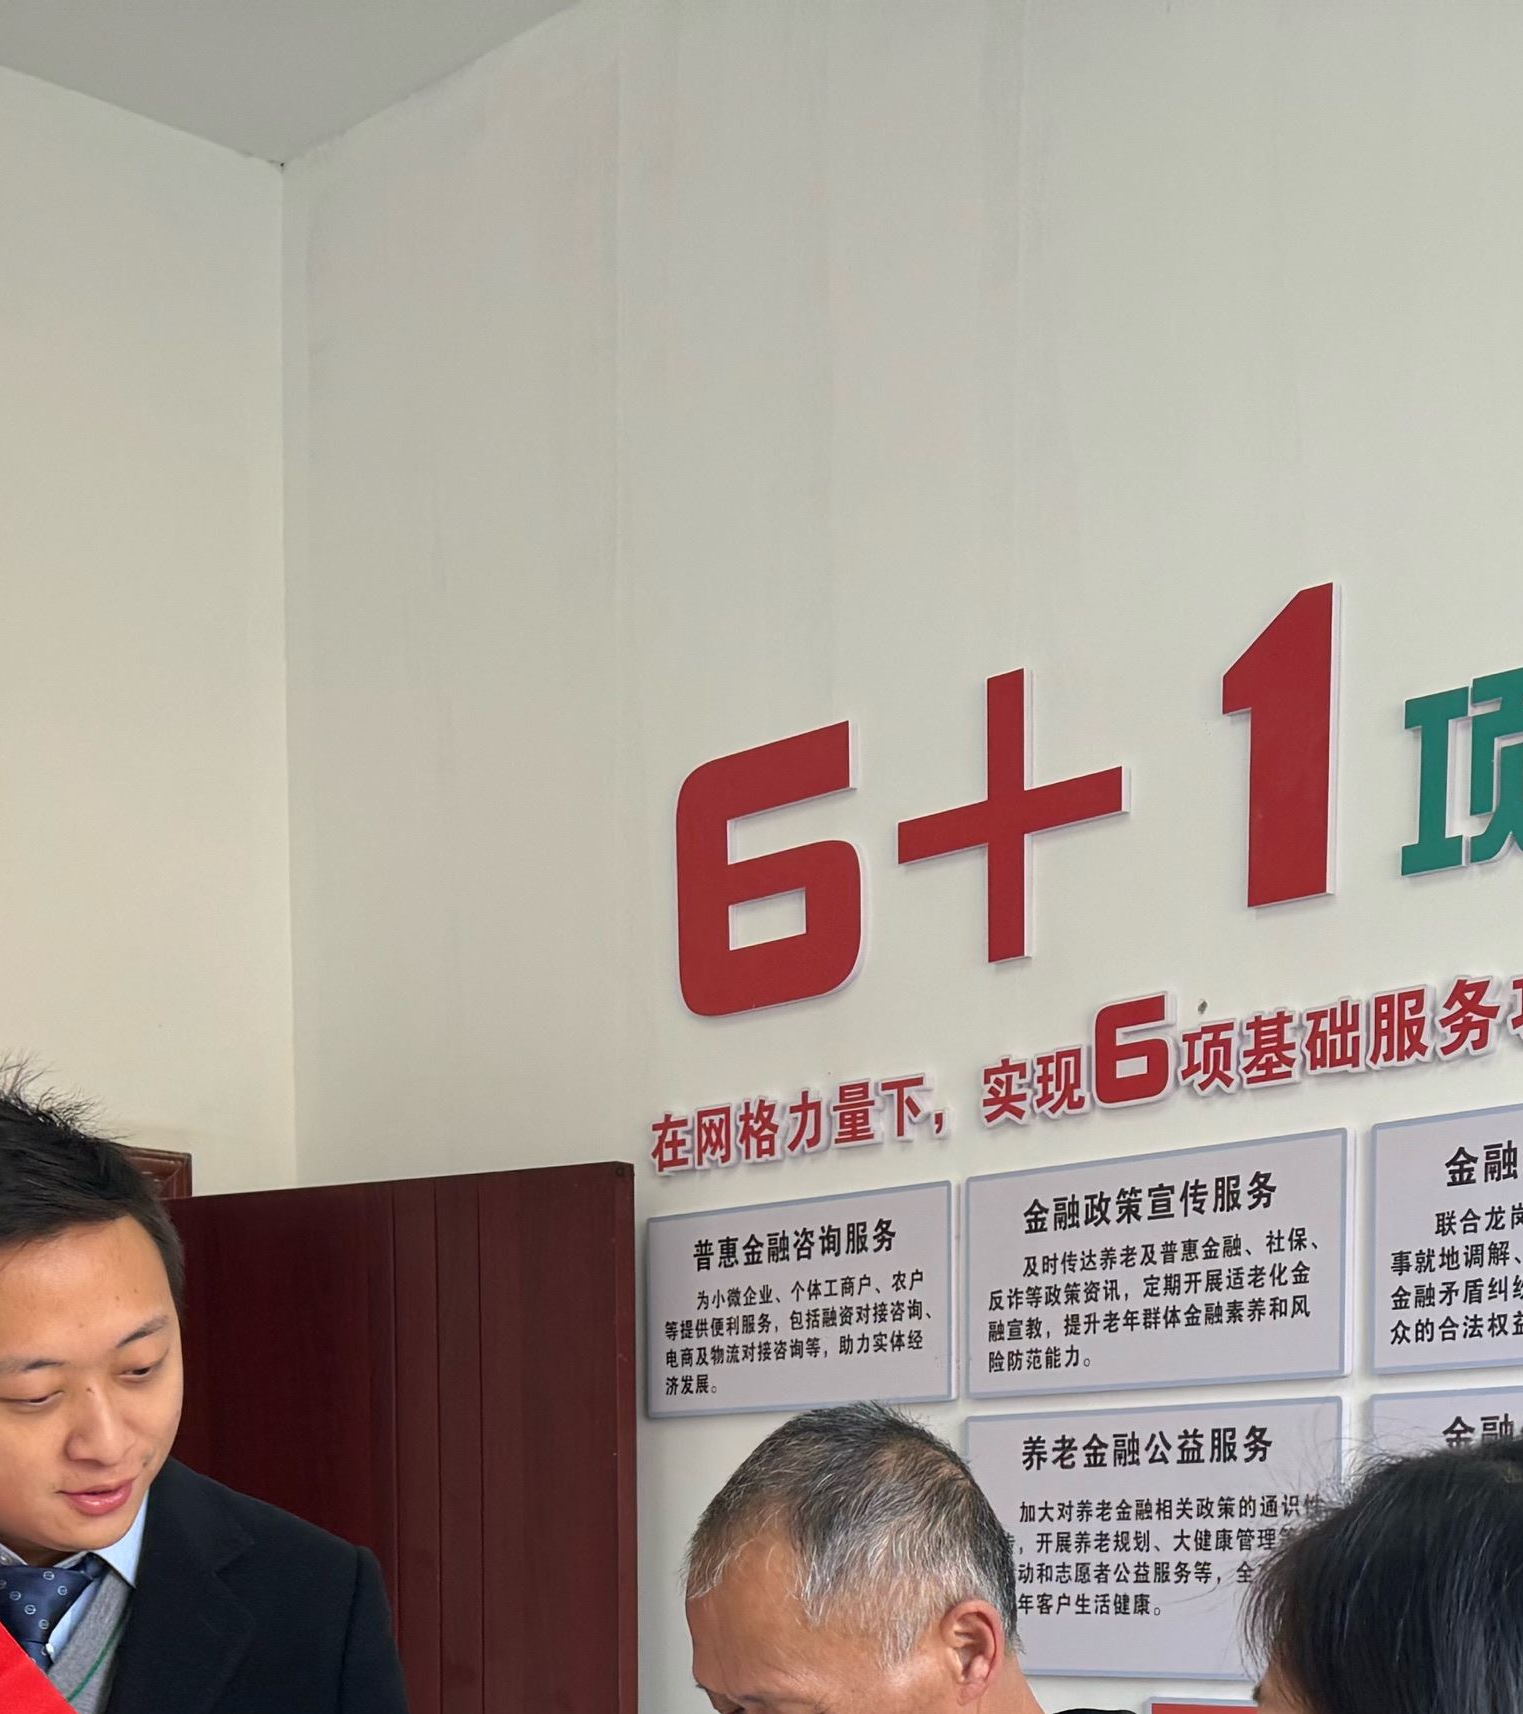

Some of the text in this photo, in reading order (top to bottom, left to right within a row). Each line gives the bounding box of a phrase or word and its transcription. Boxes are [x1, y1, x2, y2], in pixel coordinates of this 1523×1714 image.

[1023, 1170, 1277, 1235] 金融政策宣传服务
[693, 1218, 896, 1271] 普惠金融咨询服务
[1022, 1227, 1321, 1278] 及时传达养老及普惠金融、社保、
[697, 1269, 924, 1310] 为小微企业、个体工商户、农户
[988, 1260, 1311, 1311] 反诈等政策资讯，定期开展适老化金
[665, 1299, 933, 1341] 等提供便利服务，包括融资对接咨询、
[988, 1296, 1310, 1342] 融宣教，提升老年群体金融素养和风
[665, 1329, 923, 1368] 电商及物流对接咨询等，助力实体经
[988, 1345, 1091, 1373] 险防范能力。
[665, 1374, 717, 1396] 济发展。
[1022, 1425, 1272, 1470] 养老金融公益服务
[1018, 1560, 1261, 1585] 动和志愿者公益服务等，全
